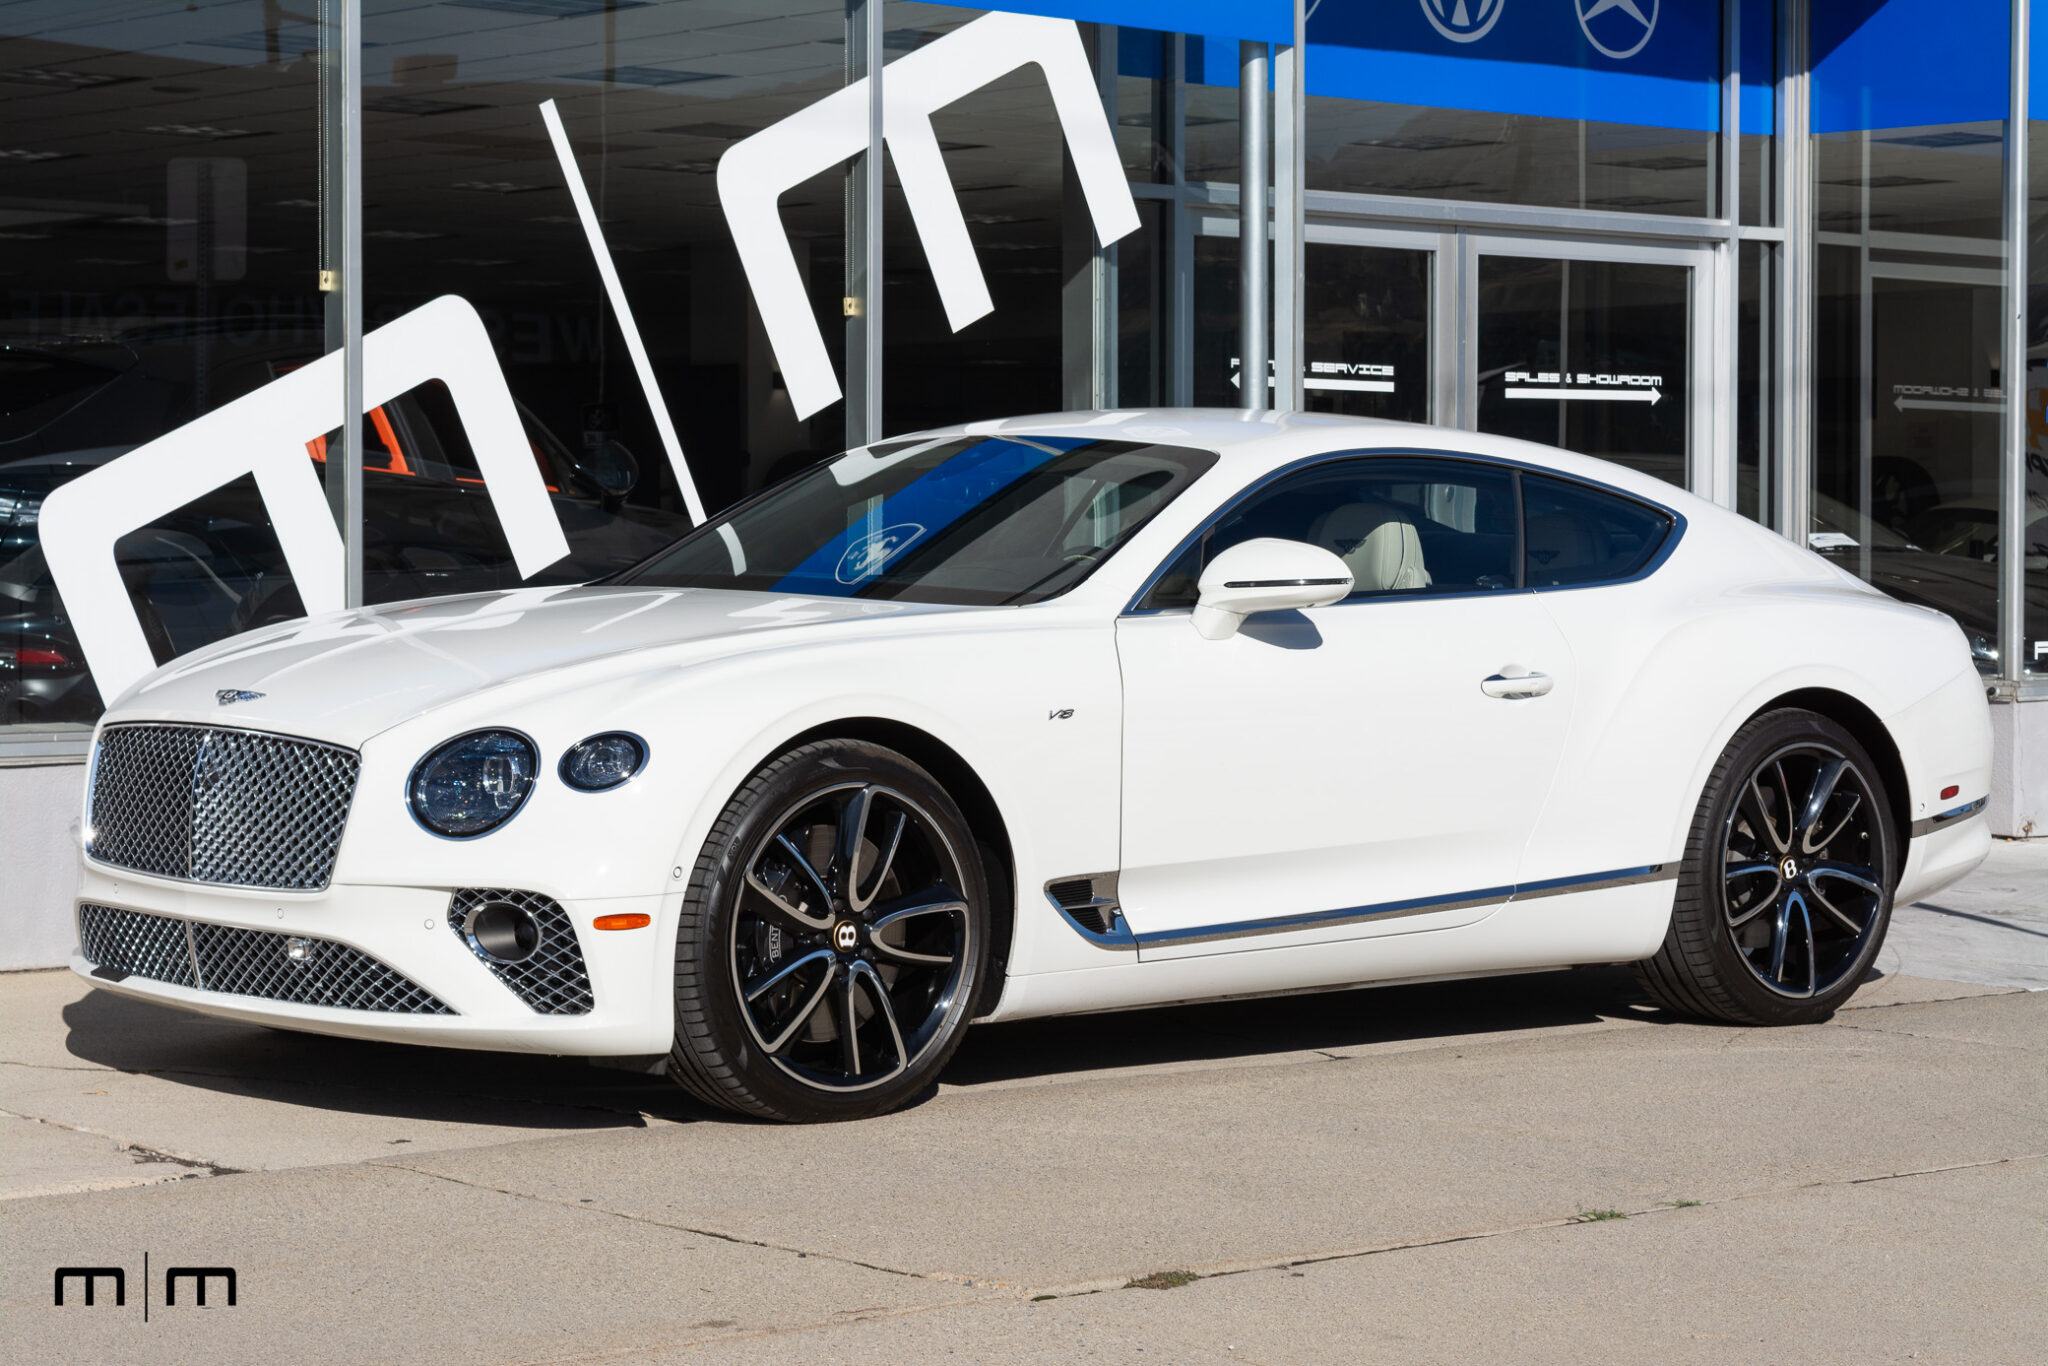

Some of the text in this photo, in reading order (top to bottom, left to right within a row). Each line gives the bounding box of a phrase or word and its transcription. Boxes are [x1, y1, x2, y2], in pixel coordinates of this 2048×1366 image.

[1311, 362, 1394, 376] SERVICE
[1505, 371, 1662, 386] SALES & SHOWROOM
[1049, 709, 1074, 720] V8
